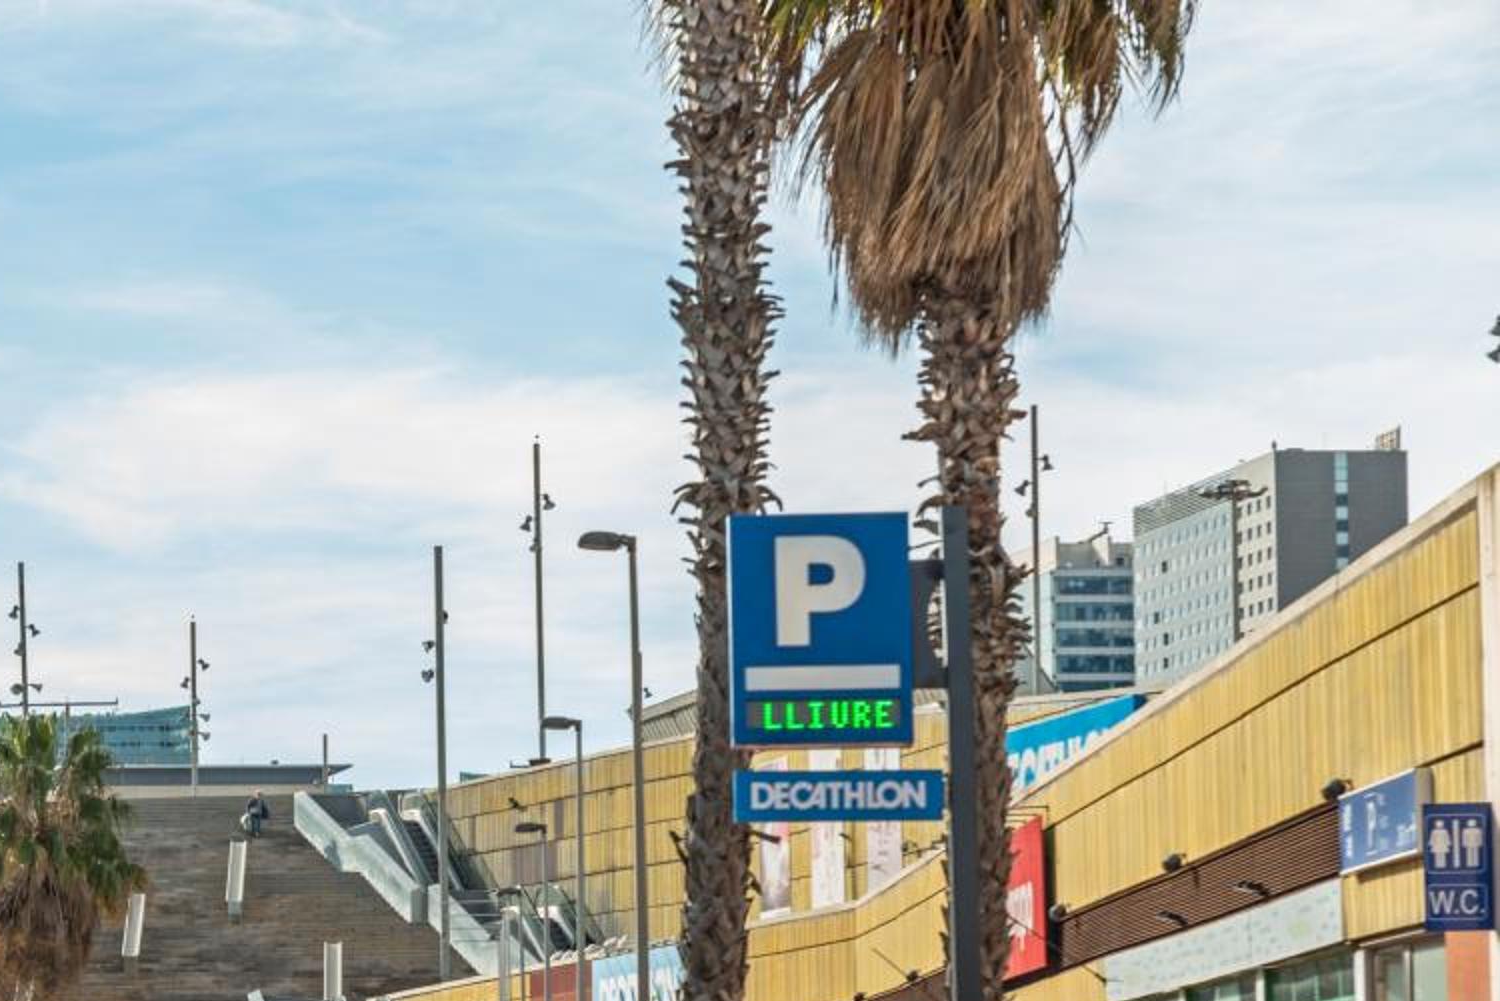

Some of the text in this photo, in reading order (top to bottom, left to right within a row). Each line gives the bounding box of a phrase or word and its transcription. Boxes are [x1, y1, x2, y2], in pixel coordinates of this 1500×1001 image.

[774, 536, 867, 646] P
[762, 700, 894, 730] LLIURE
[750, 779, 927, 810] DECATHLON
[1428, 889, 1486, 915] W.C.
